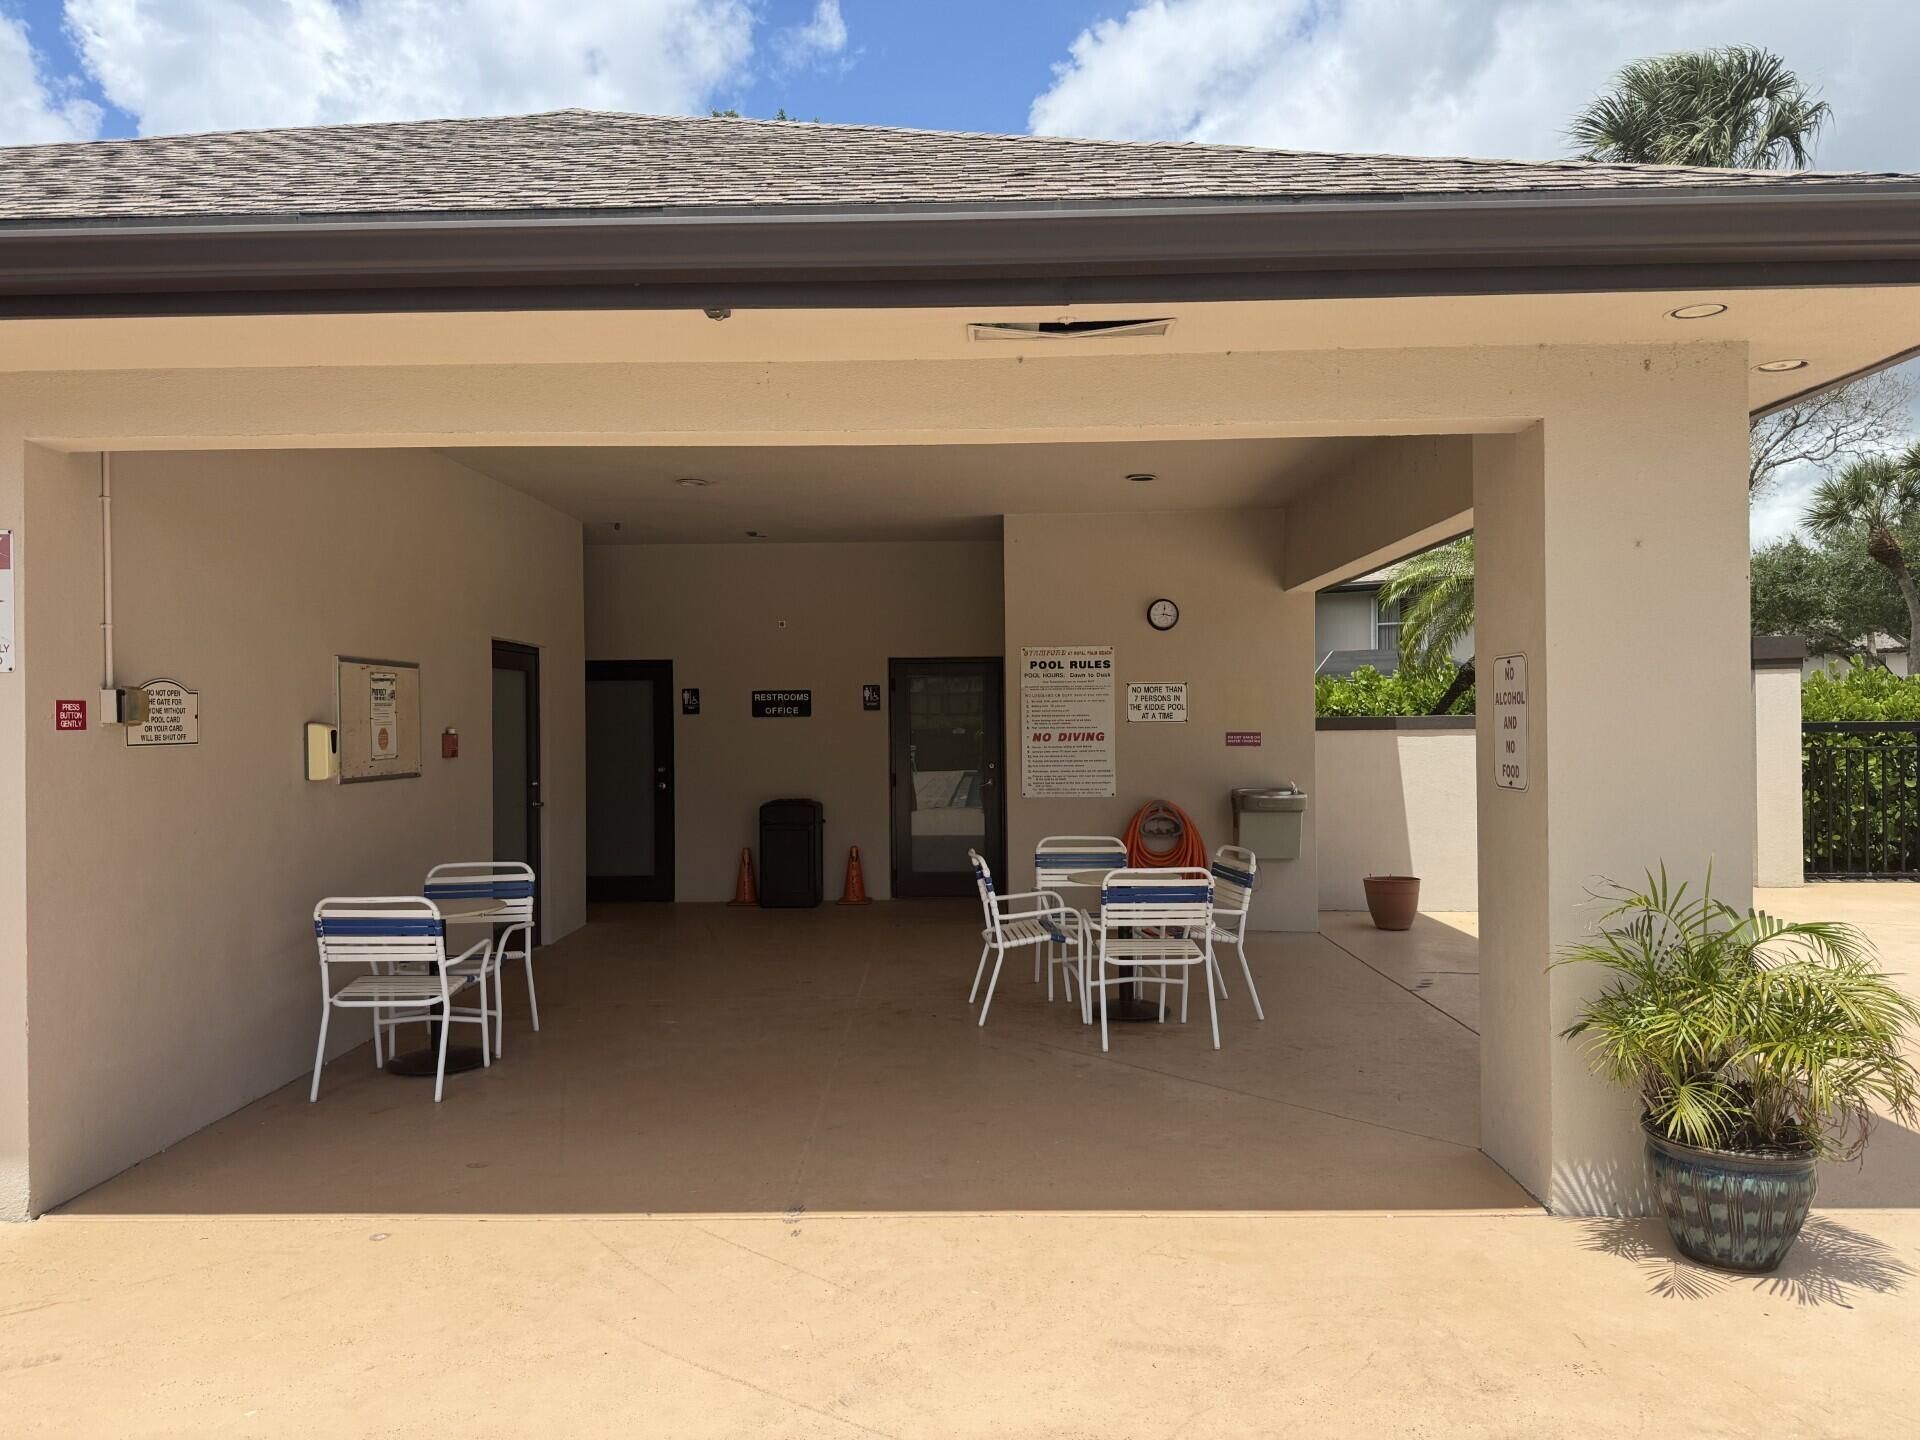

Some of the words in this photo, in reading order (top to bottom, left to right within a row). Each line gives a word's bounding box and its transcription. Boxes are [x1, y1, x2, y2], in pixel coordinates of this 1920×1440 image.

[1030, 660, 1064, 669] POOL
[1069, 659, 1111, 669] RULES
[1504, 667, 1514, 680] NO
[166, 689, 181, 697] OPEN
[754, 693, 809, 701] RESTROOMS
[1495, 691, 1526, 705] ALCOHOL
[62, 703, 81, 711] PRESS
[765, 706, 799, 714] OFFICE
[59, 711, 83, 719] BUTTON
[60, 720, 82, 728] GENTLY
[1504, 716, 1517, 729] AND
[1032, 732, 1052, 742] NO
[1058, 732, 1105, 742] DIVING
[1505, 740, 1516, 753] NO
[1502, 764, 1520, 778] FOOD
